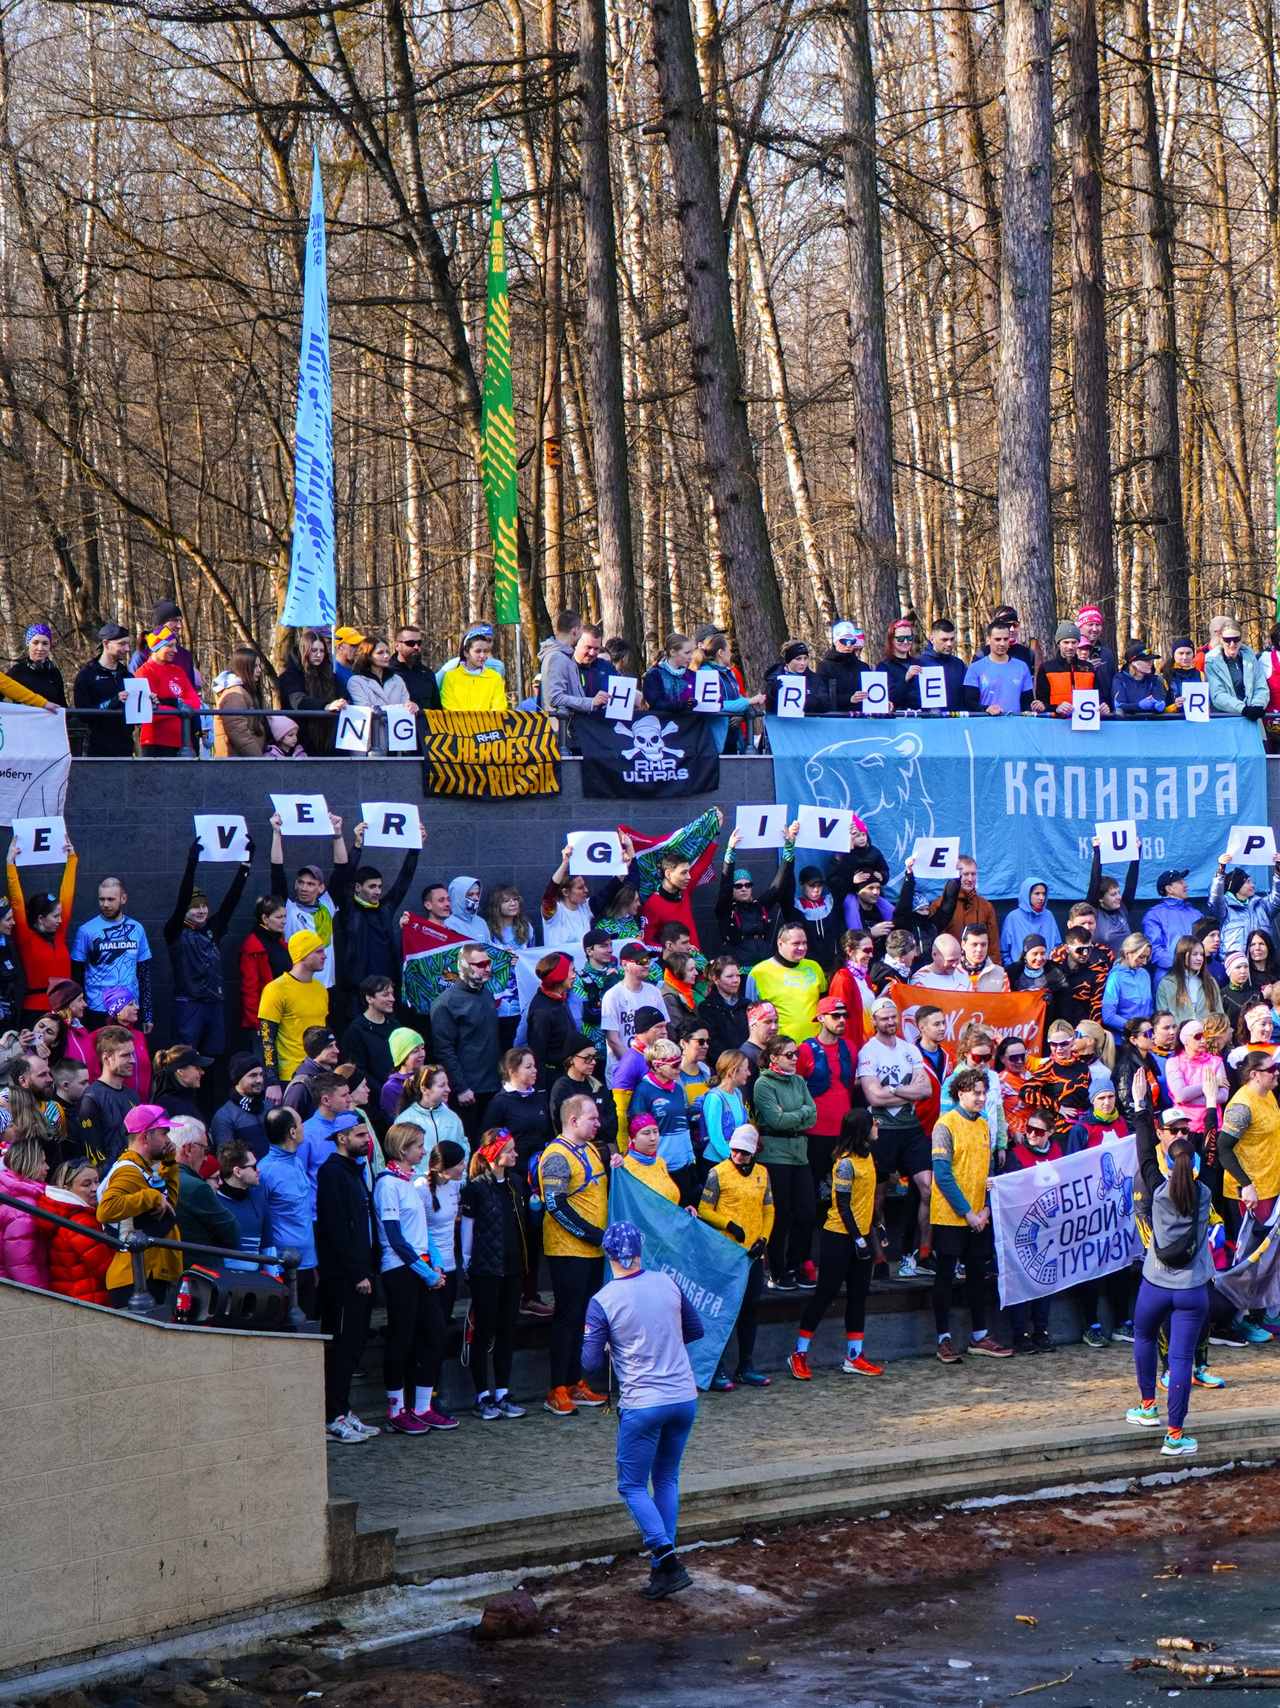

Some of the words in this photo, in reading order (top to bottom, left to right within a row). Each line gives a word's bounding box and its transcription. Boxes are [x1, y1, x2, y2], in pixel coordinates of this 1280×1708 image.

[609, 685, 631, 708] H
[702, 682, 717, 702] E
[783, 687, 802, 709] R
[867, 683, 886, 703] O
[926, 677, 941, 698] E
[1078, 701, 1095, 720] S
[1189, 693, 1205, 713] R
[340, 717, 367, 740] N
[393, 718, 414, 740] G
[424, 709, 509, 737] RUNNING
[476, 731, 501, 742] RHR
[457, 736, 529, 764] HEROES
[0, 768, 33, 782] ибегут
[623, 768, 689, 783] ULTRAS
[634, 759, 677, 772] RHR
[487, 763, 560, 797] RUSSIA
[1004, 761, 1238, 821] КАПИБАРА
[295, 803, 314, 823] E
[381, 812, 406, 835] R
[758, 815, 768, 836] I
[818, 817, 839, 838] V
[33, 827, 51, 852] E
[217, 826, 237, 849] V
[1111, 830, 1127, 851] U
[1243, 835, 1265, 854] P
[586, 842, 612, 864] G
[929, 847, 949, 867] E
[100, 941, 137, 951] MALIDAK
[1060, 1174, 1094, 1214] БЕГ
[1059, 1198, 1118, 1246] ОВОЙ
[1059, 1228, 1136, 1278] ТУРИЗМ
[660, 1263, 723, 1317] КАПИБАРА
